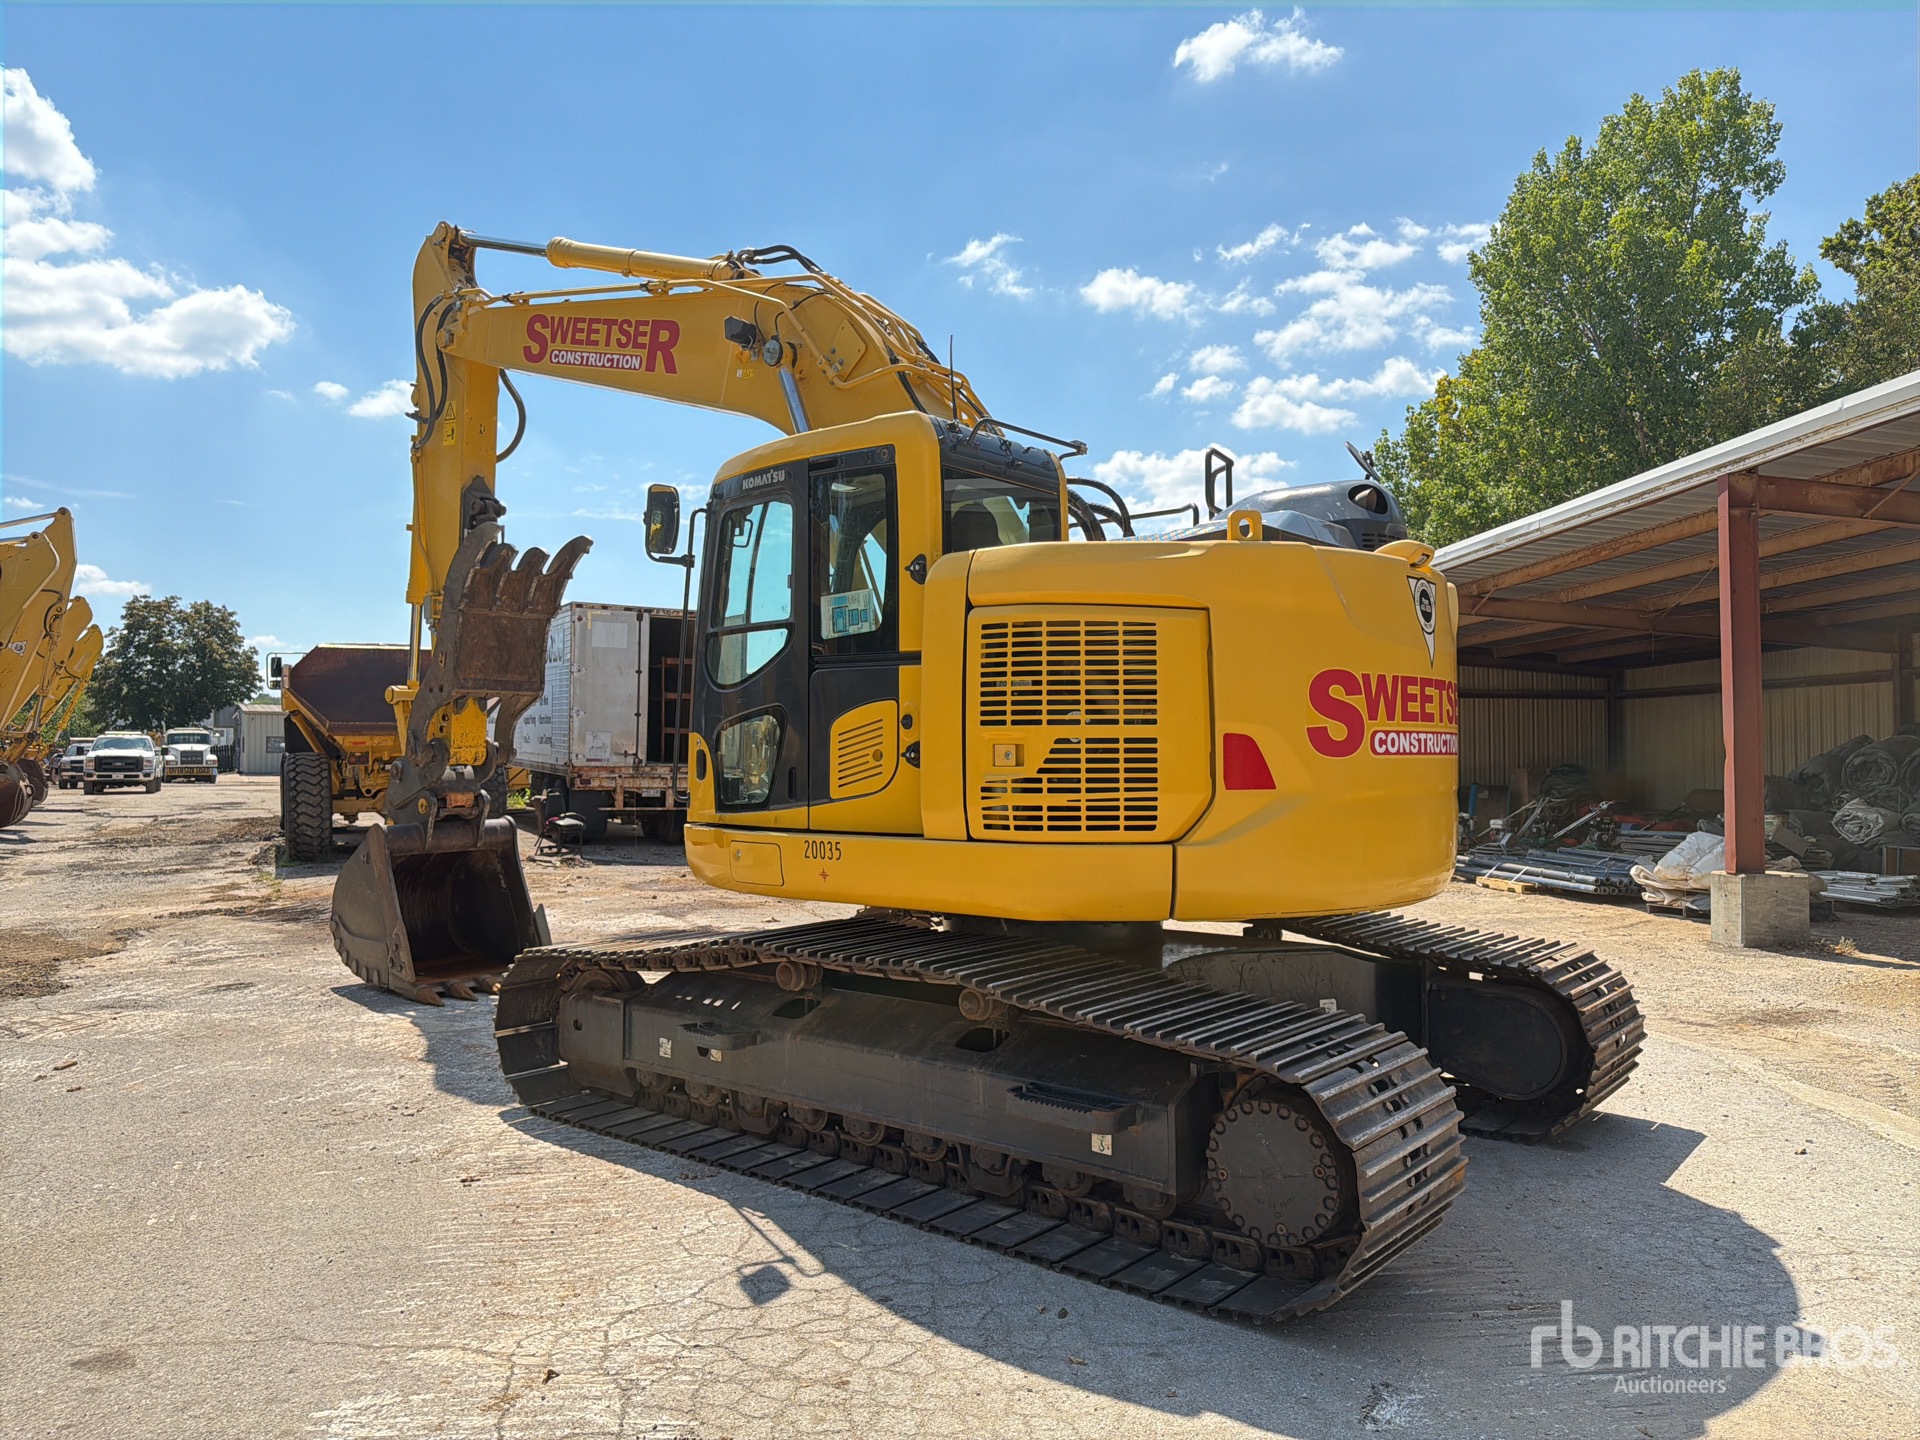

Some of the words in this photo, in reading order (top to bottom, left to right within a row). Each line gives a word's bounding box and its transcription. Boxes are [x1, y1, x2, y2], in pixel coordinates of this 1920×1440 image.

[523, 313, 680, 374] SWEETSER
[551, 350, 640, 370] CONSTRUCTION
[742, 469, 786, 490] KOMATSU
[1306, 668, 1458, 758] SWEETSE
[196, 767, 211, 775] LOAD
[804, 840, 842, 861] 20035
